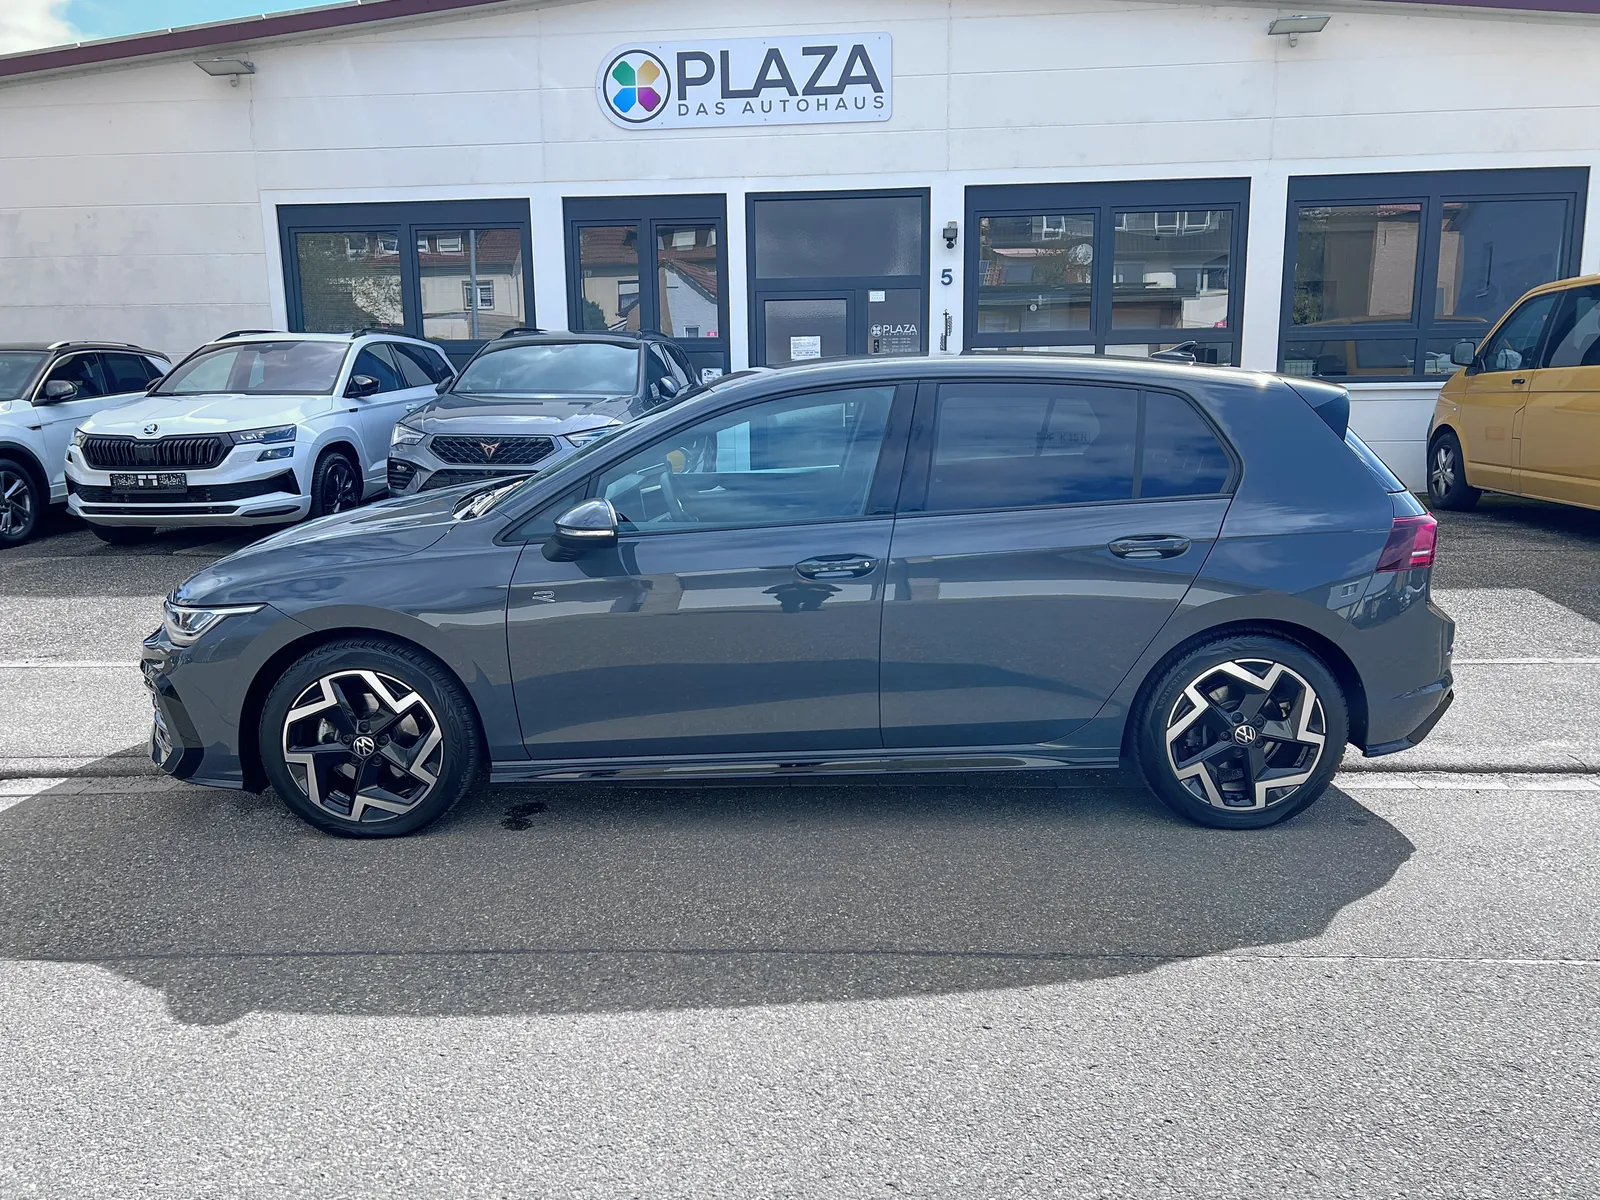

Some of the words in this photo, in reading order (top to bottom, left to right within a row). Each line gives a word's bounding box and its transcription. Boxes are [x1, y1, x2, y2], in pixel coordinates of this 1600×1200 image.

[677, 44, 884, 101] PLAZA
[677, 102, 726, 117] DAS
[741, 95, 885, 115] AUTOHAUS
[941, 268, 953, 286] 5
[882, 324, 917, 334] PLAZA
